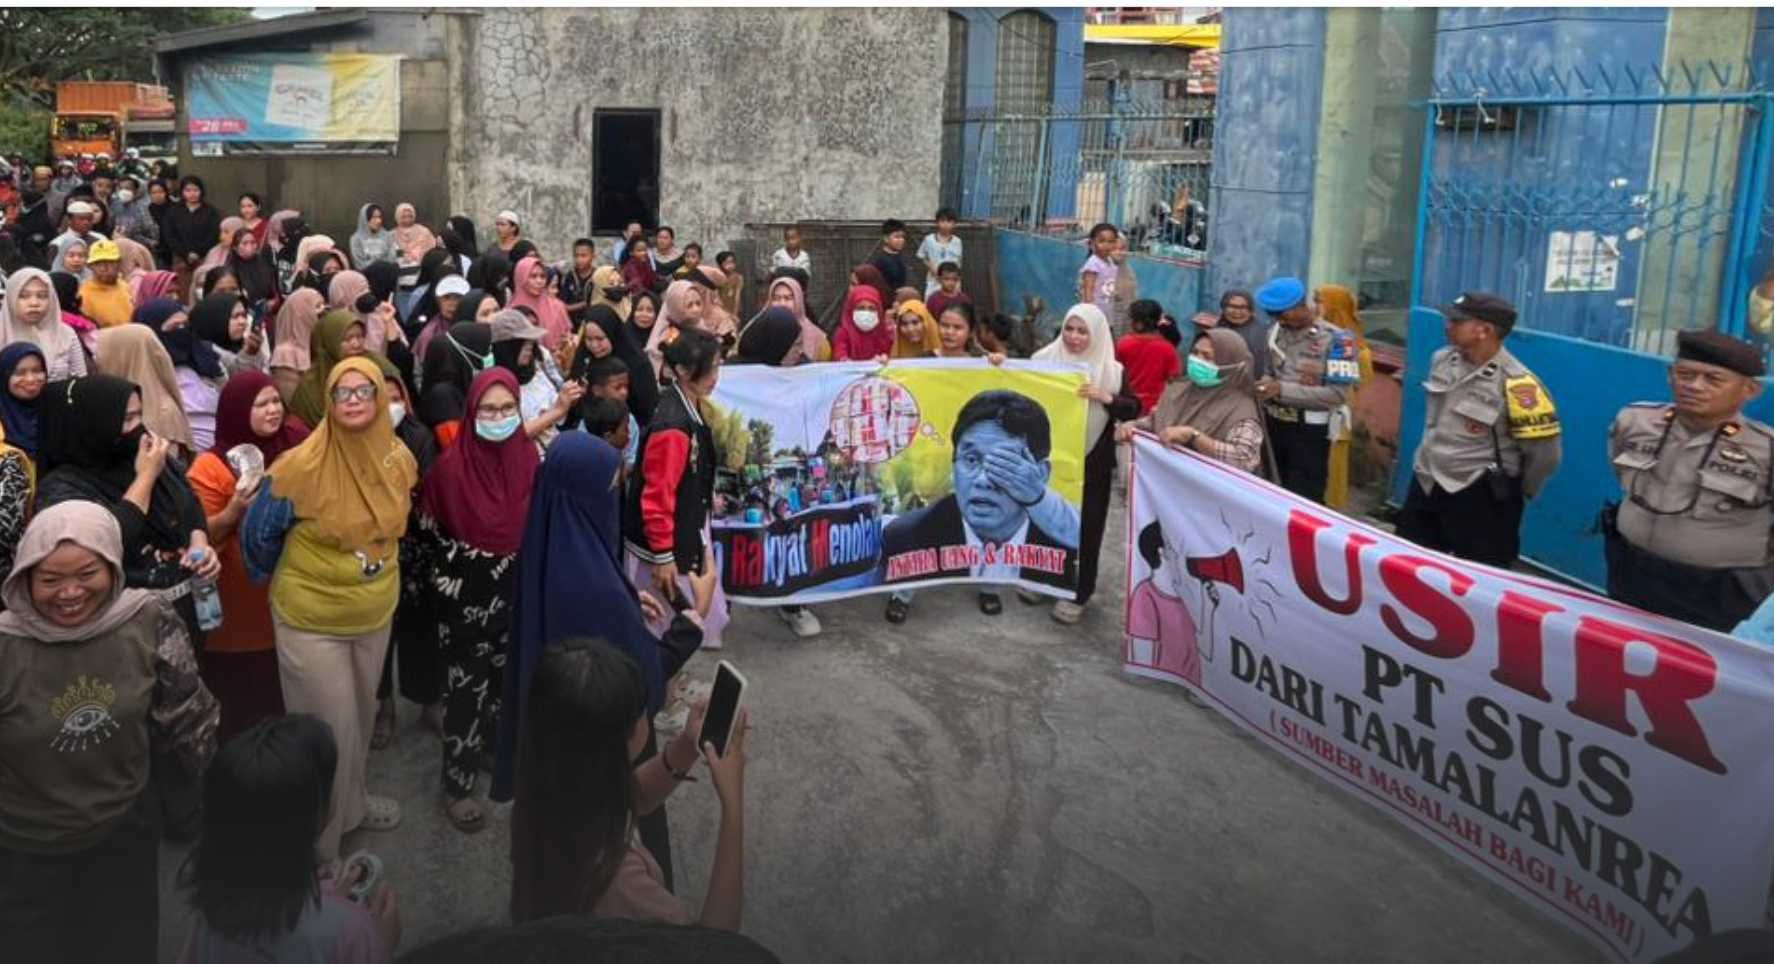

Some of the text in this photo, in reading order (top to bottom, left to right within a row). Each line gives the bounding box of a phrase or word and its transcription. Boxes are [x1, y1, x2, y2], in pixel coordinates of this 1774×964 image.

[732, 523, 808, 588] Rakyat
[984, 541, 996, 567] &
[1001, 543, 1067, 576] RAKYAT
[1287, 509, 1728, 775] USIR
[1229, 636, 1714, 941] DARI TAMALANREA
[1280, 718, 1363, 780] SUMBER
[1368, 767, 1483, 848] MASALAH
[1489, 831, 1556, 893] BAGI
[1362, 644, 1634, 817] PT SUS
